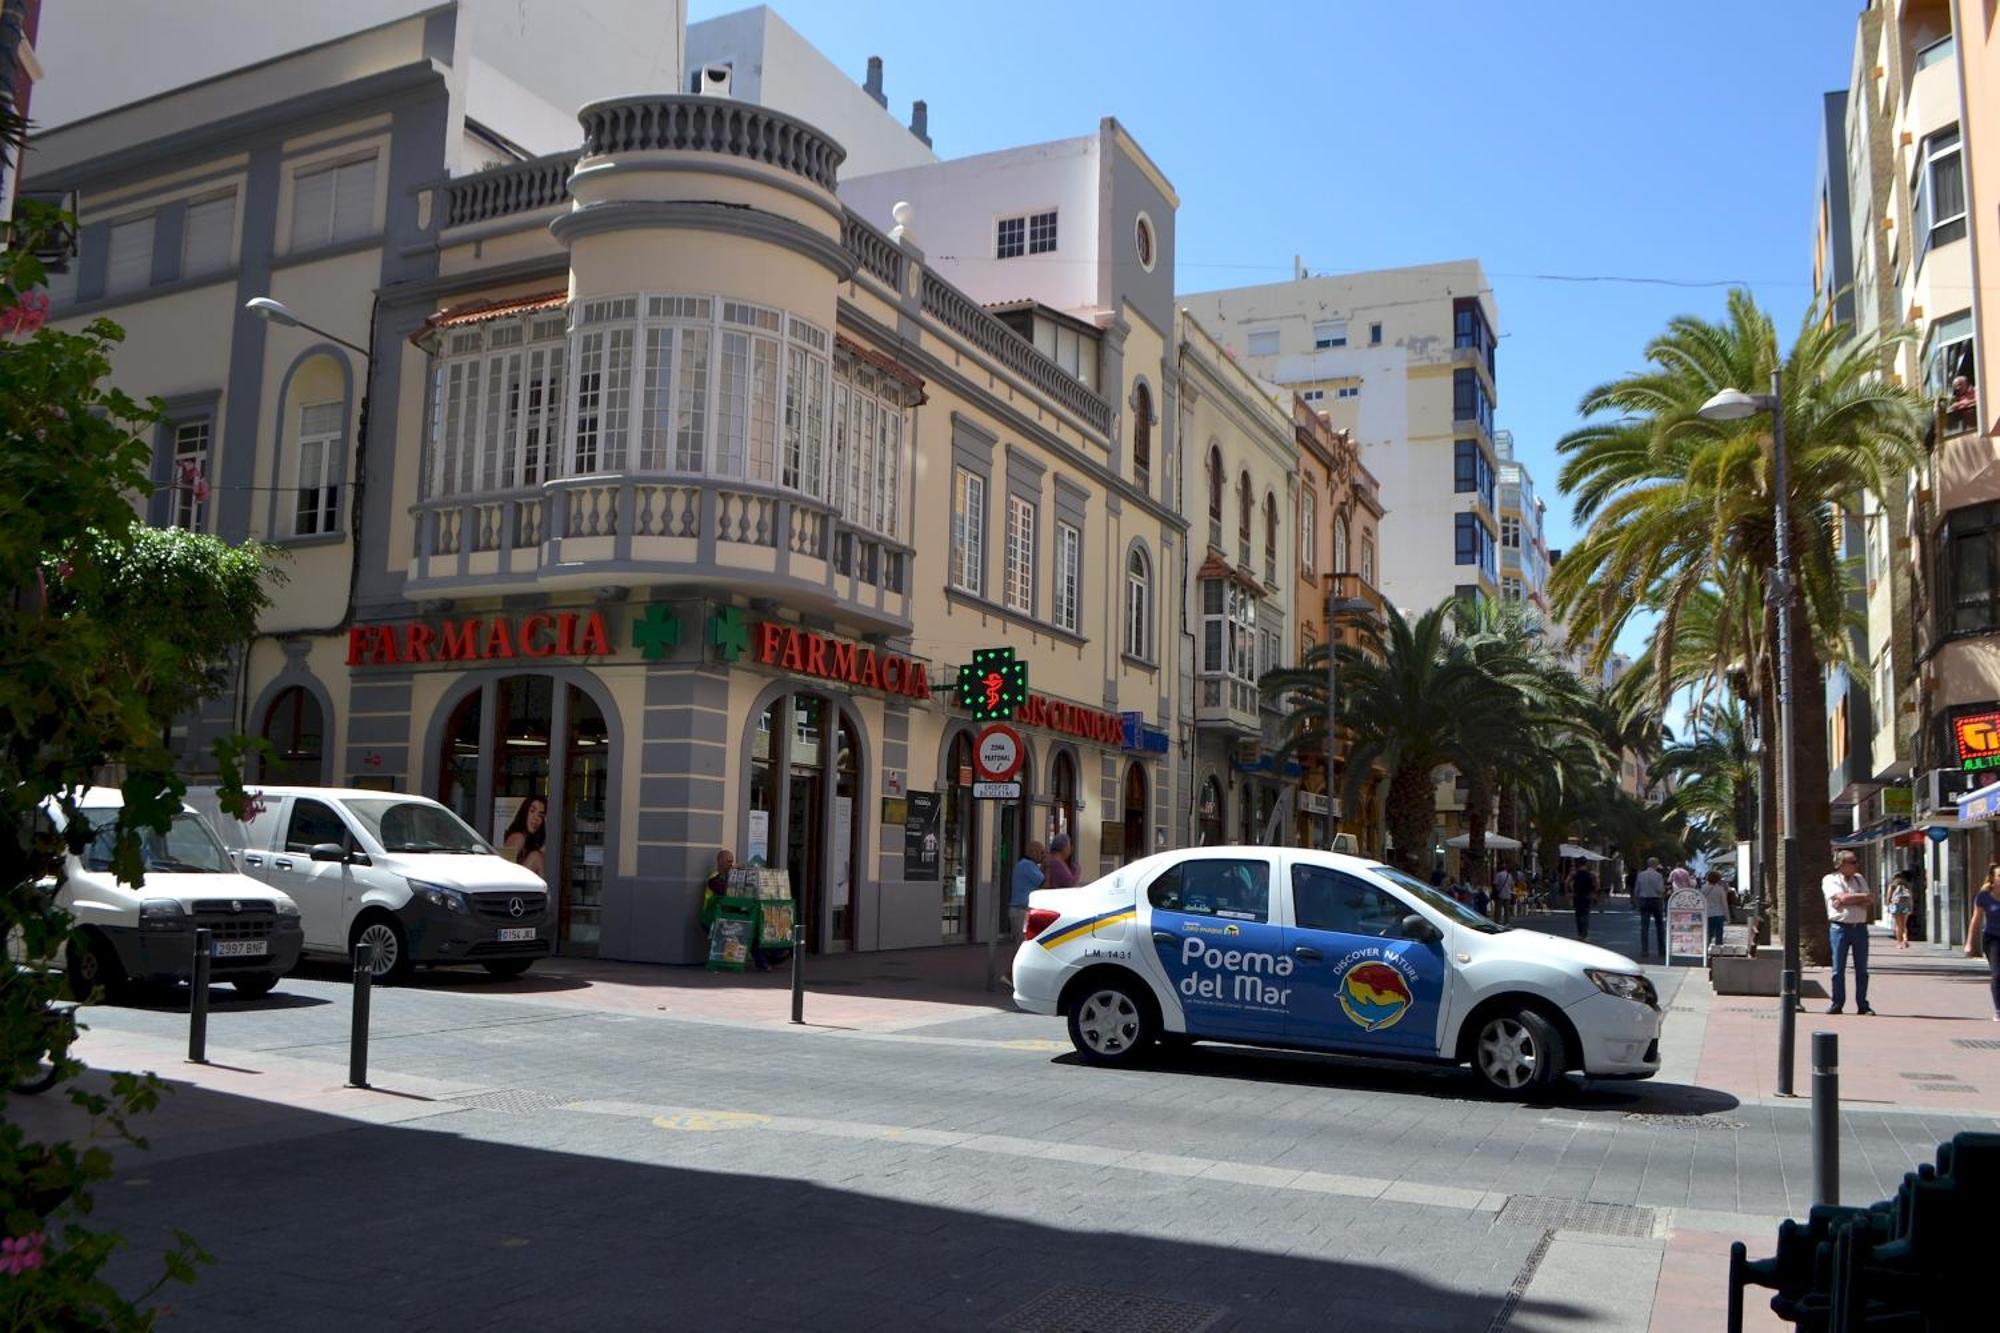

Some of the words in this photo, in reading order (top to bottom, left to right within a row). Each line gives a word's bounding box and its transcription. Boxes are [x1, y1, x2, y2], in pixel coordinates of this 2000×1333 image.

[346, 610, 612, 666] FARMACIA
[758, 620, 930, 700] FARMACIA
[218, 943, 244, 955] 2997
[1182, 937, 1294, 976] Poema
[1333, 947, 1380, 976] DISCOVER
[1384, 950, 1420, 983] NATURE
[1180, 971, 1223, 999] del
[1234, 975, 1292, 1005] Mar
